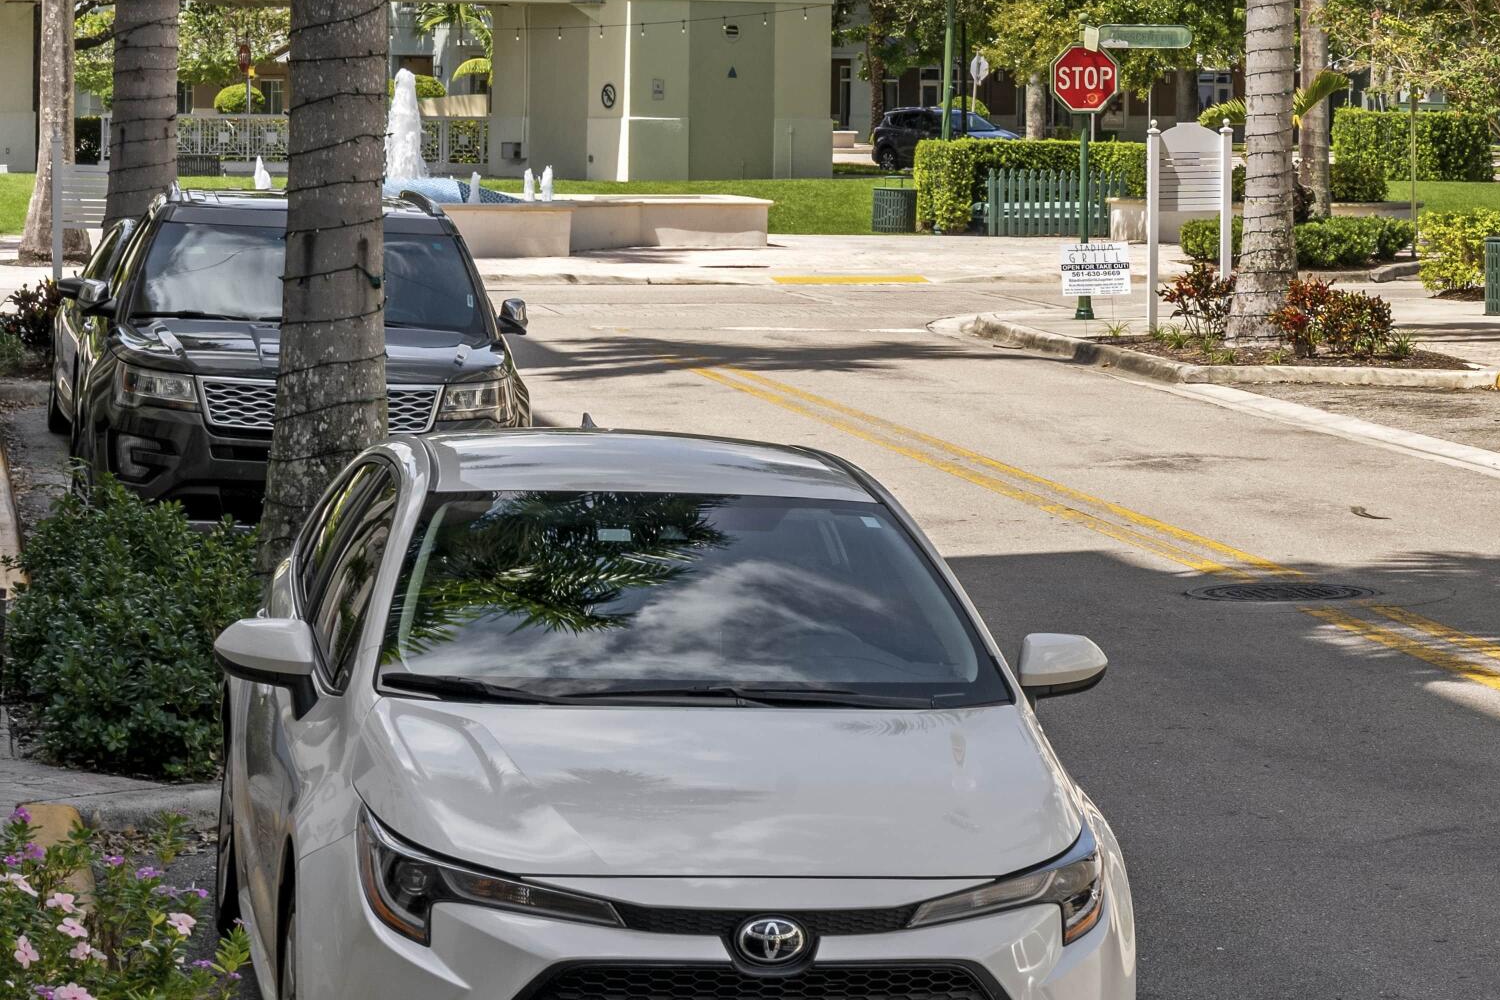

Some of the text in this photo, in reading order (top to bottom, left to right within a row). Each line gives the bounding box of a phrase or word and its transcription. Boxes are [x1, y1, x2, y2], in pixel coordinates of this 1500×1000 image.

[1058, 66, 1113, 90] STOP
[1075, 244, 1114, 252] STADIUM
[1069, 252, 1121, 263] GRILL
[1071, 270, 1121, 278] 561-630-9669
